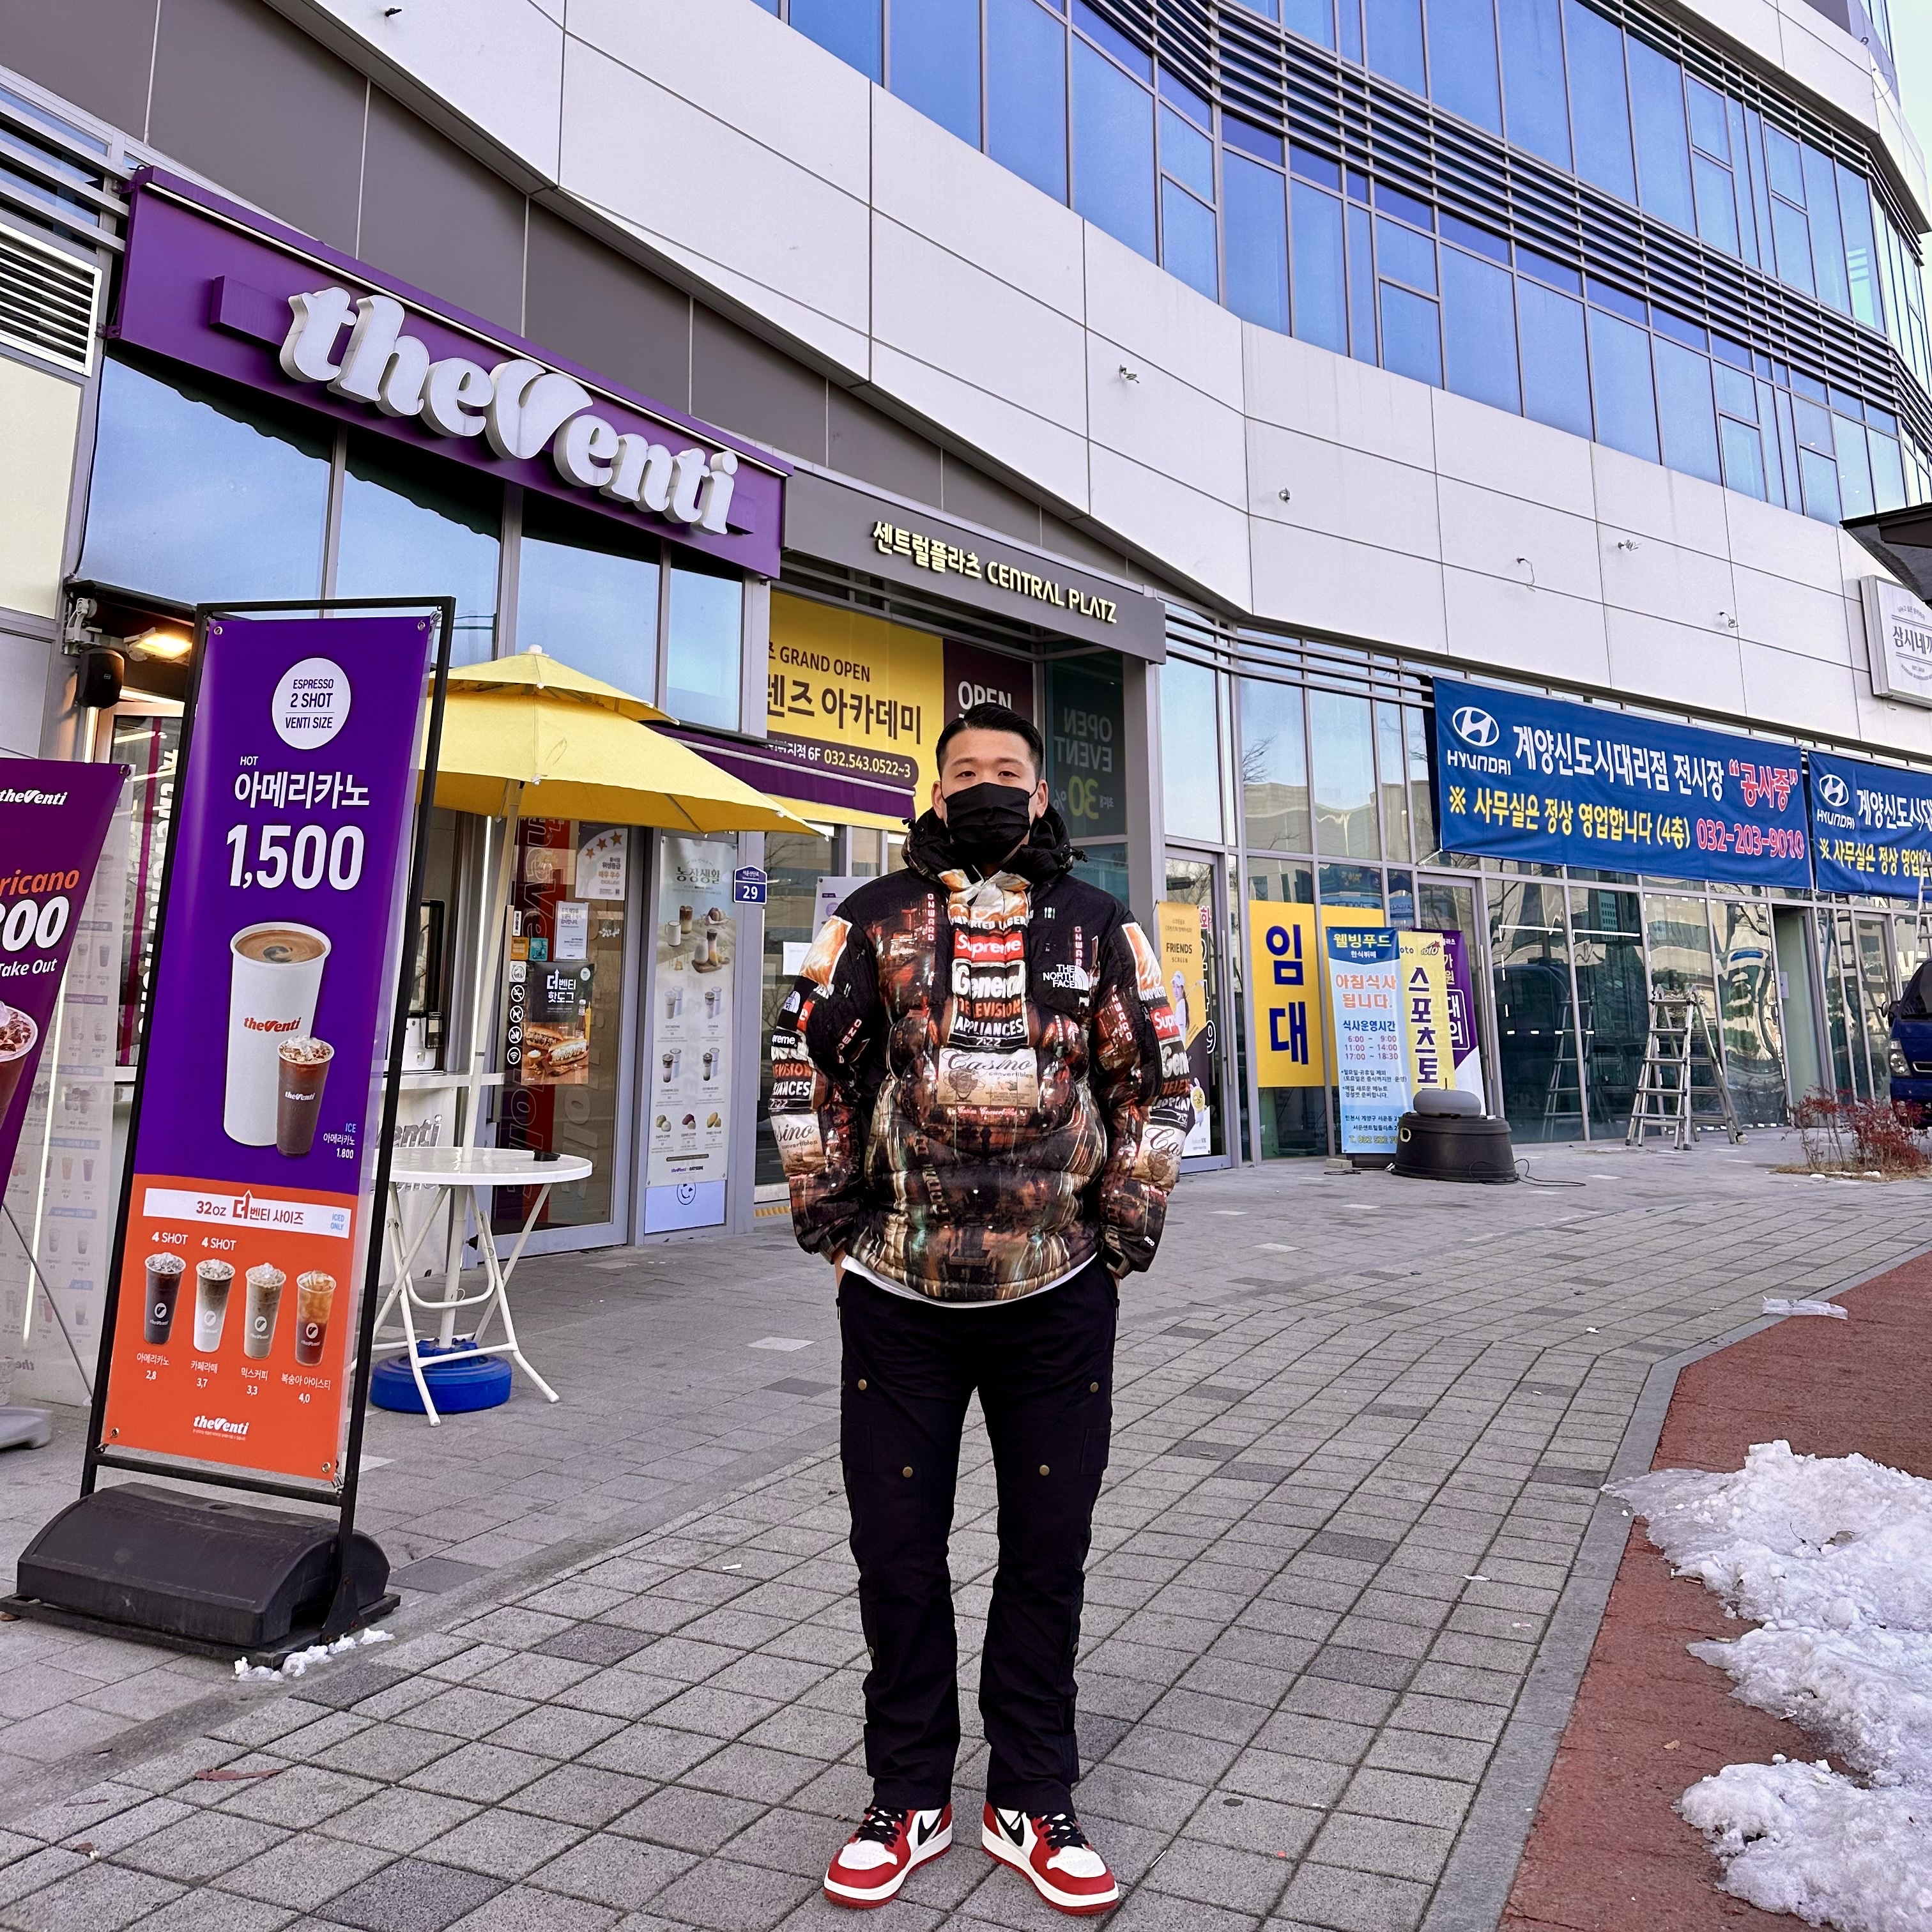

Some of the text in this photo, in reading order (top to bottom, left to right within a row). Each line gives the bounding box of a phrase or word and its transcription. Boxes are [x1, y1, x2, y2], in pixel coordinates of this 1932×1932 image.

[280, 286, 739, 535] theVenti
[873, 520, 1117, 624] 센트럴플라츠 CENTRAL PLATZ
[779, 645, 831, 673] GRAND
[833, 659, 870, 682] OPEN
[293, 678, 334, 689] ESPRESSO
[290, 693, 334, 708] 2 SHOT
[286, 717, 334, 729] VENTI SIZE
[822, 687, 921, 745] 아카데미
[240, 756, 259, 766] HOT
[808, 747, 821, 761] 6F
[824, 749, 911, 778] 032.543.0522~3
[1448, 749, 1512, 775] HYUNDAI
[1513, 725, 1668, 792] 계양신도시대리점
[1673, 754, 1724, 802] 전시장
[234, 771, 370, 809] 아메리카노
[1473, 790, 1805, 860] 사무실은 정상 영업합니다 (4층) 032-203-9010
[1817, 808, 1855, 830] HYUNDAI
[227, 824, 364, 891] 1,500
[1834, 839, 1876, 873] 사무실은
[1878, 846, 1899, 876] 정상
[676, 866, 721, 885] 농장생활
[743, 885, 758, 900] 29
[928, 893, 936, 941] ONWARD
[956, 934, 1022, 959] Supreme
[1074, 926, 1083, 967] ONWAR
[1166, 942, 1193, 954] FRIENDS
[1333, 933, 1392, 949] 웰빙푸드
[1350, 949, 1377, 959] 한식뷔페
[33, 958, 58, 974] Out
[1056, 963, 1075, 972] THE
[546, 969, 577, 990] 더벤티
[1043, 972, 1075, 981] NORTH
[1052, 980, 1075, 988] FACE
[1335, 974, 1397, 990] 아침식사
[548, 991, 574, 1004] 핫도그
[1266, 924, 1309, 1066] 임대
[1342, 993, 1393, 1009] 됩니다.
[243, 1017, 302, 1032] theVenti
[954, 1016, 1024, 1036] APPLIANCES
[1343, 1020, 1396, 1032] 식사운영시간
[1408, 967, 1441, 1090] 스포츠토
[345, 1123, 357, 1133] ICE
[323, 1132, 356, 1146] 아메리카노
[336, 1147, 355, 1160] 1,800
[195, 1200, 227, 1216] 32oz
[272, 1209, 304, 1225] 사이즈
[332, 1213, 345, 1222] ICED
[330, 1222, 344, 1231] ONLY
[151, 1231, 188, 1245] 4 SHOT
[201, 1237, 237, 1251] 4 SHOT
[136, 1352, 170, 1366] 아메리카노
[190, 1360, 218, 1374] 카페라떼
[240, 1367, 269, 1381] 믹스커피
[281, 1373, 331, 1390] 복숭아 아이스티
[193, 1415, 249, 1435] theVenti
